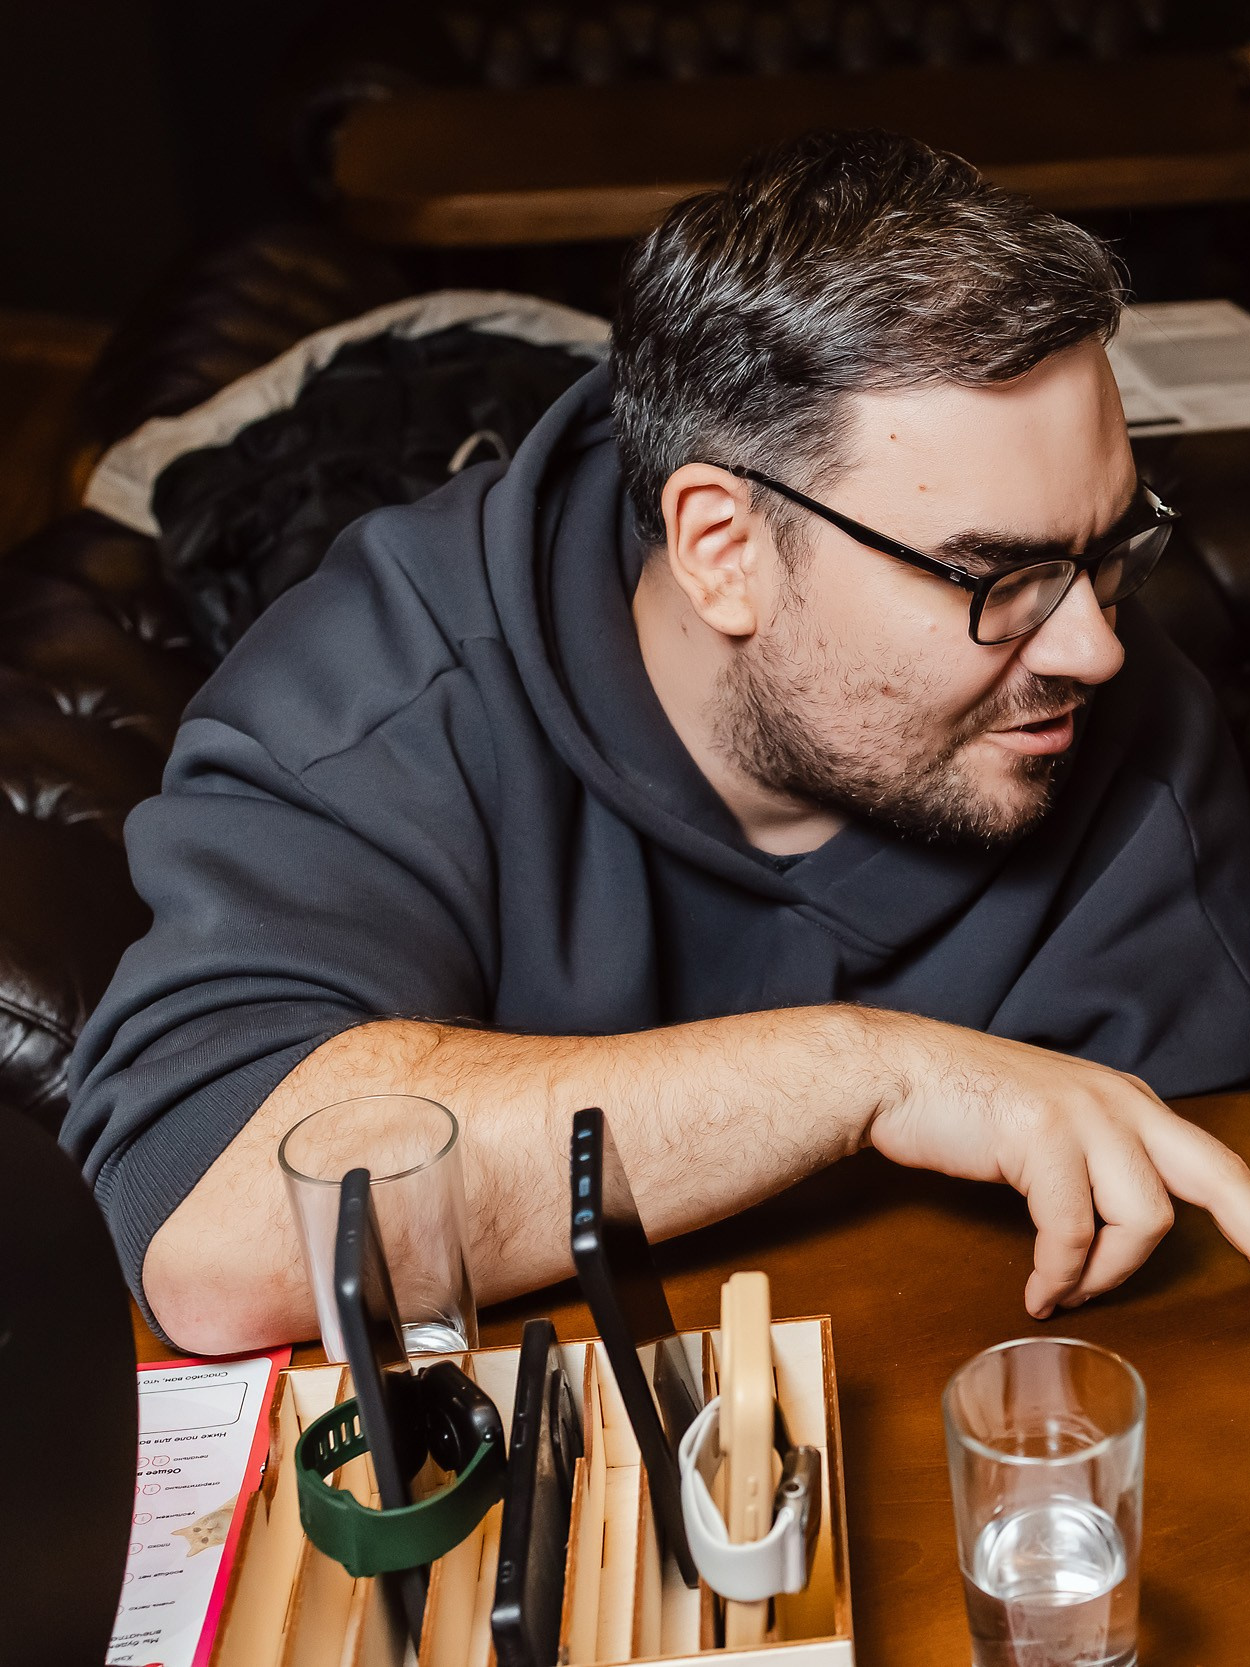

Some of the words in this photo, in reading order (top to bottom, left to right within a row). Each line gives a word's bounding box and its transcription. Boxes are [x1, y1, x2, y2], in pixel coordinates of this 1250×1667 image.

[162, 1376, 183, 1385] вам,
[185, 1371, 228, 1382] Спасибо
[144, 1378, 160, 1386] что
[174, 1434, 198, 1442] поле
[201, 1432, 227, 1440] Ниже
[154, 1437, 172, 1445] для
[146, 1467, 182, 1477] Общее
[110, 1629, 162, 1641] впечатле
